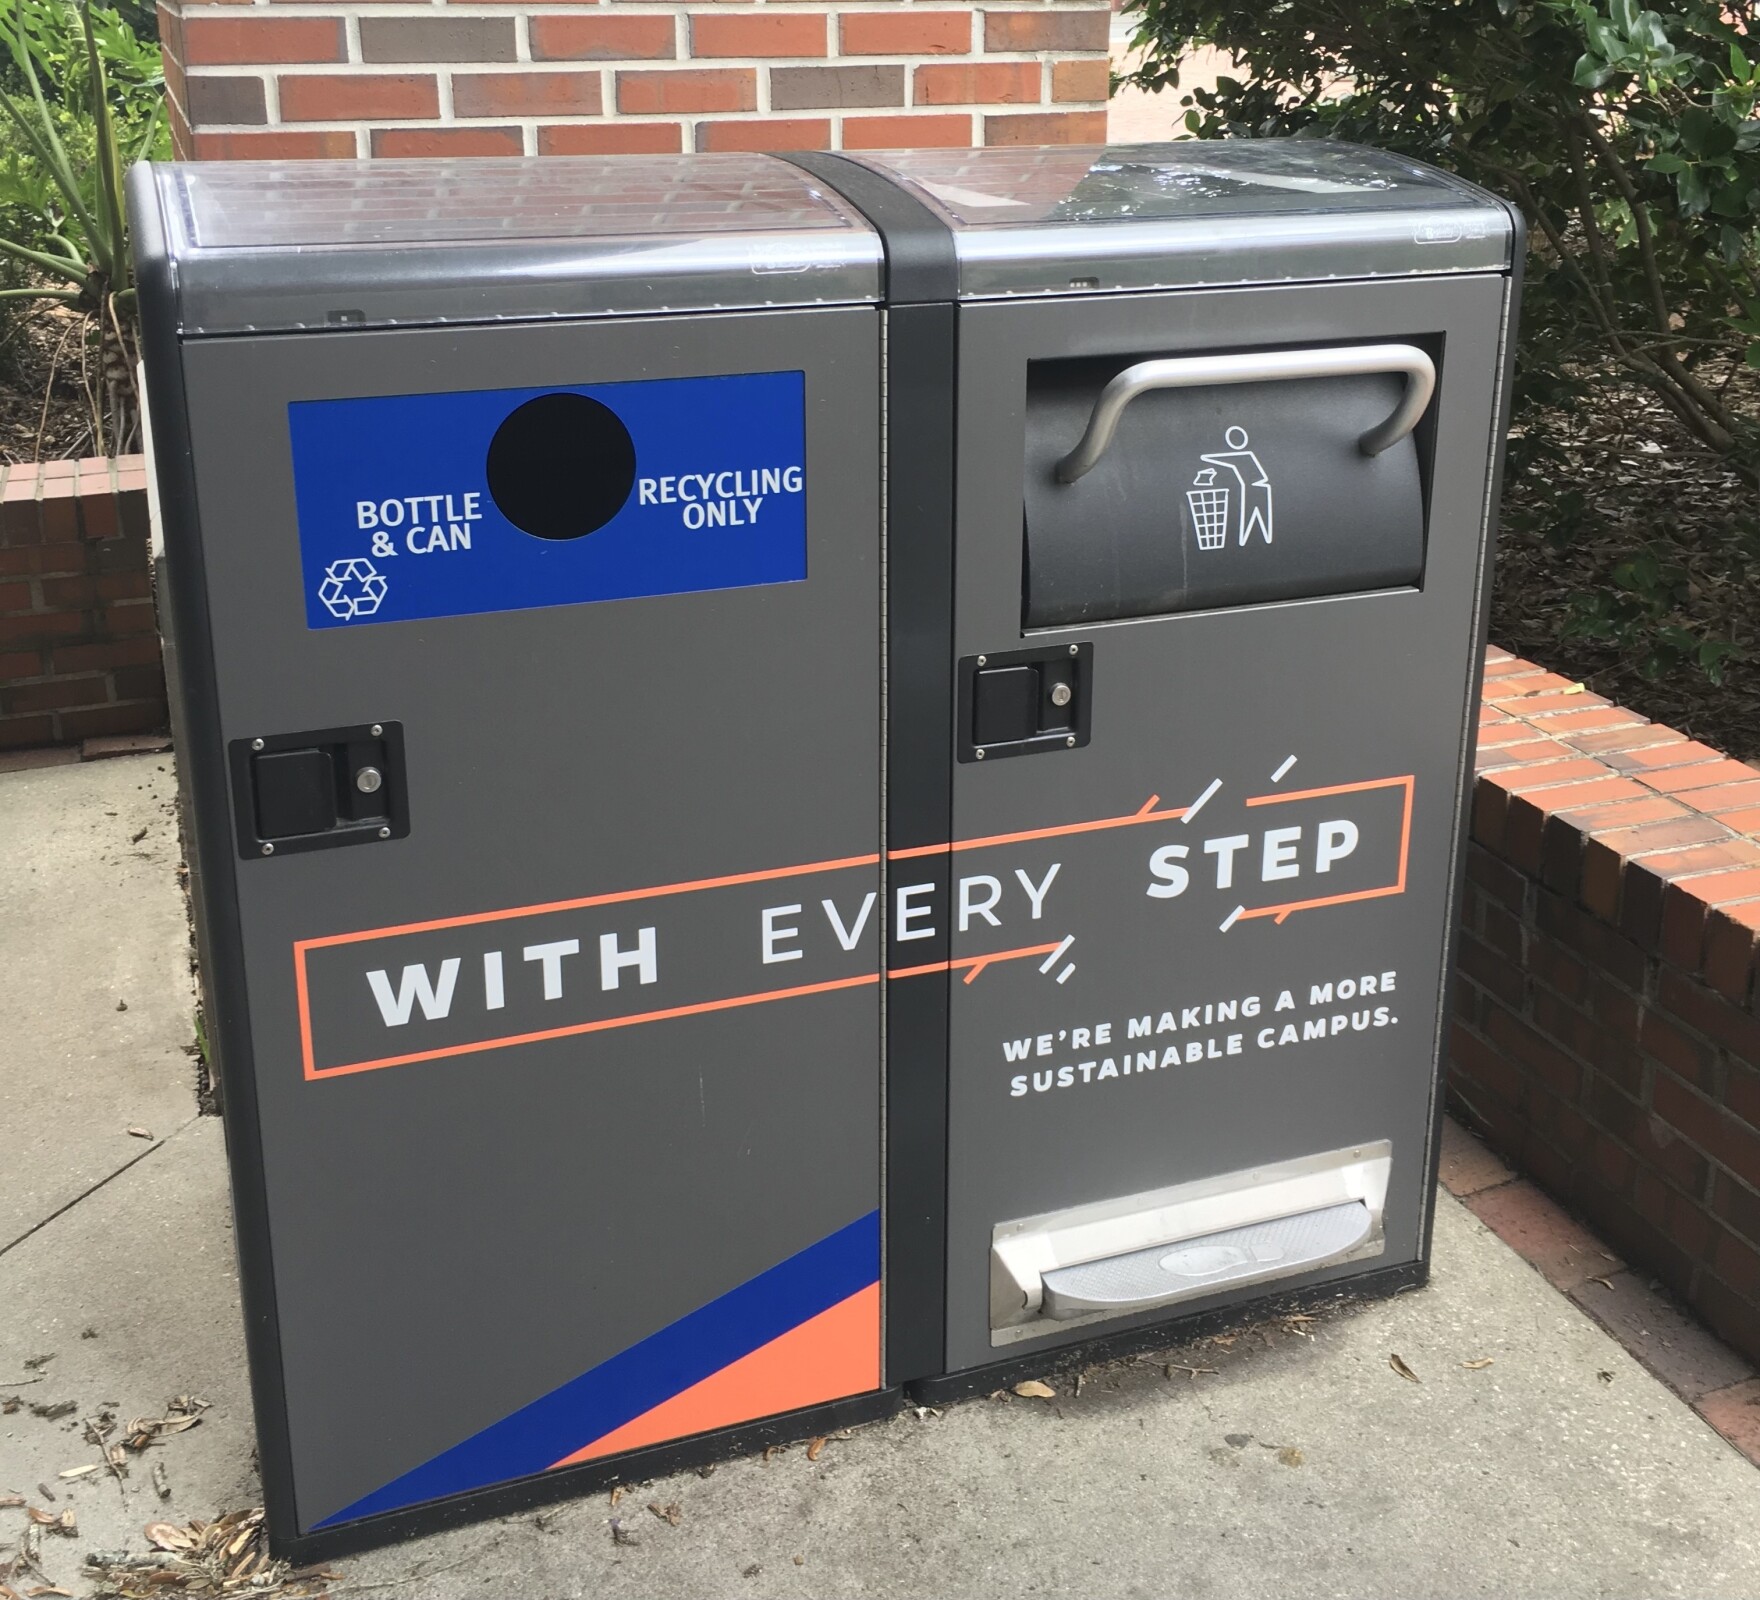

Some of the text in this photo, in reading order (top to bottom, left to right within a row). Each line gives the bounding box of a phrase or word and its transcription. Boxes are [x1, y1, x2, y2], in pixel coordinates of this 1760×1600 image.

[639, 466, 802, 505] RECYCLING
[357, 492, 482, 529] BOTTLE
[683, 498, 763, 529] ONLY
[371, 523, 472, 558] & CAN
[366, 819, 1359, 1027] WITH EVERY STEP
[1127, 996, 1261, 1039] MAKING
[1275, 990, 1295, 1011] A
[1309, 970, 1397, 1006] MORE
[1010, 1006, 1400, 1097] SUSTAINABLE CAMPUS.
